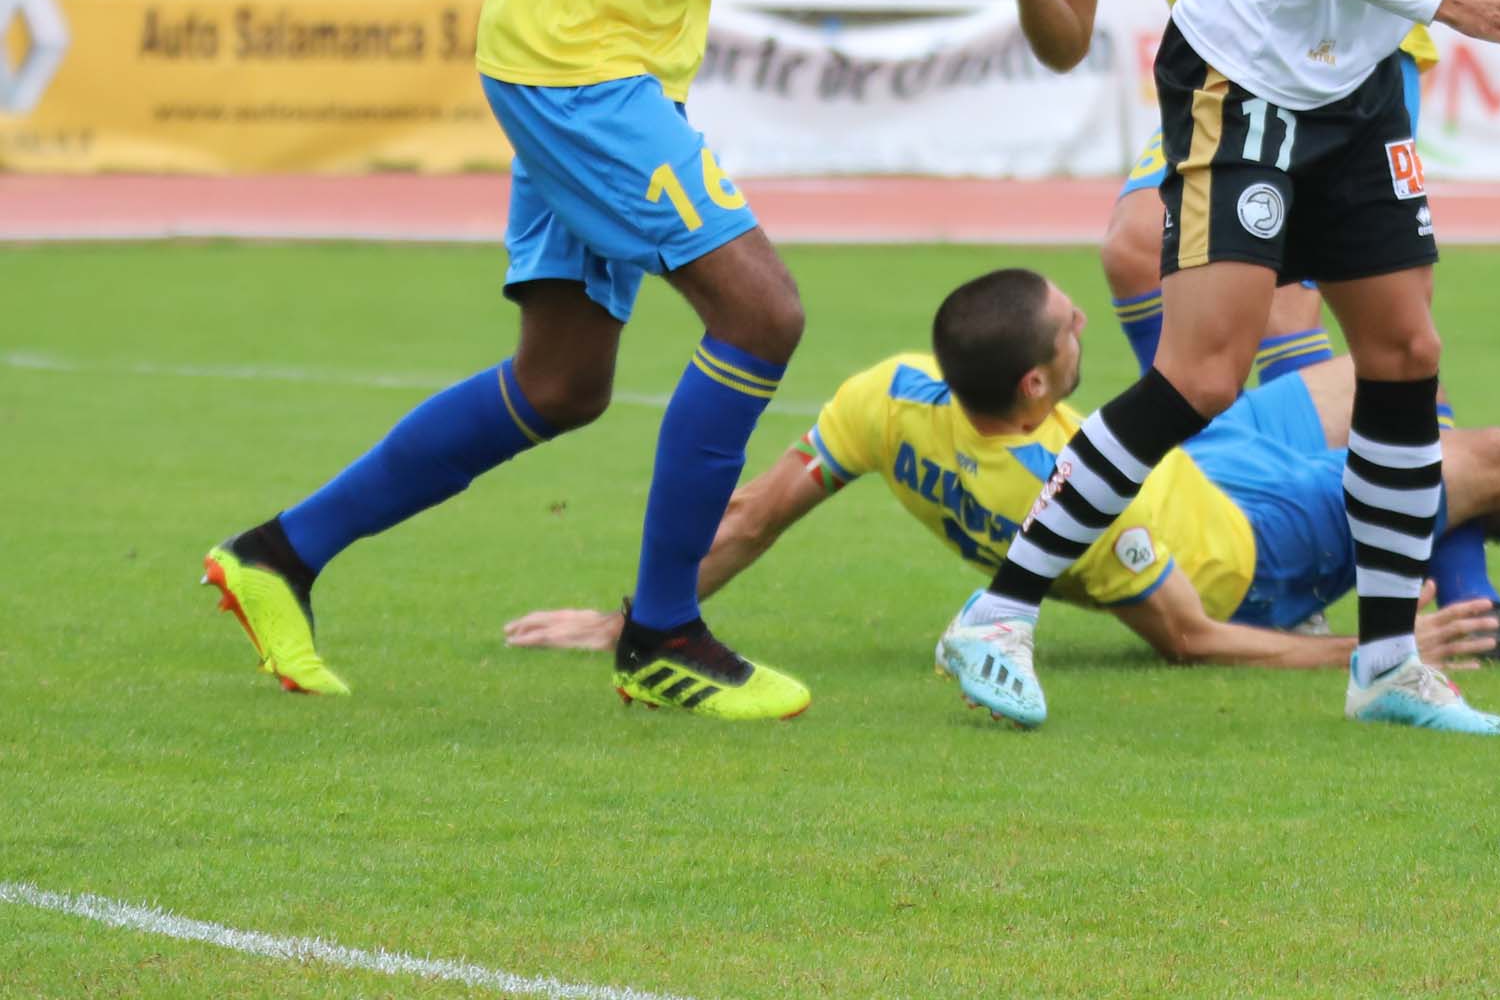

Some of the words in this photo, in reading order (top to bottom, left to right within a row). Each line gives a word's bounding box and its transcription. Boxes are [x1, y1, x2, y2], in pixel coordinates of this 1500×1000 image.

[140, 5, 219, 58] Auto
[233, 5, 426, 60] Salamanca
[645, 147, 749, 232] 16
